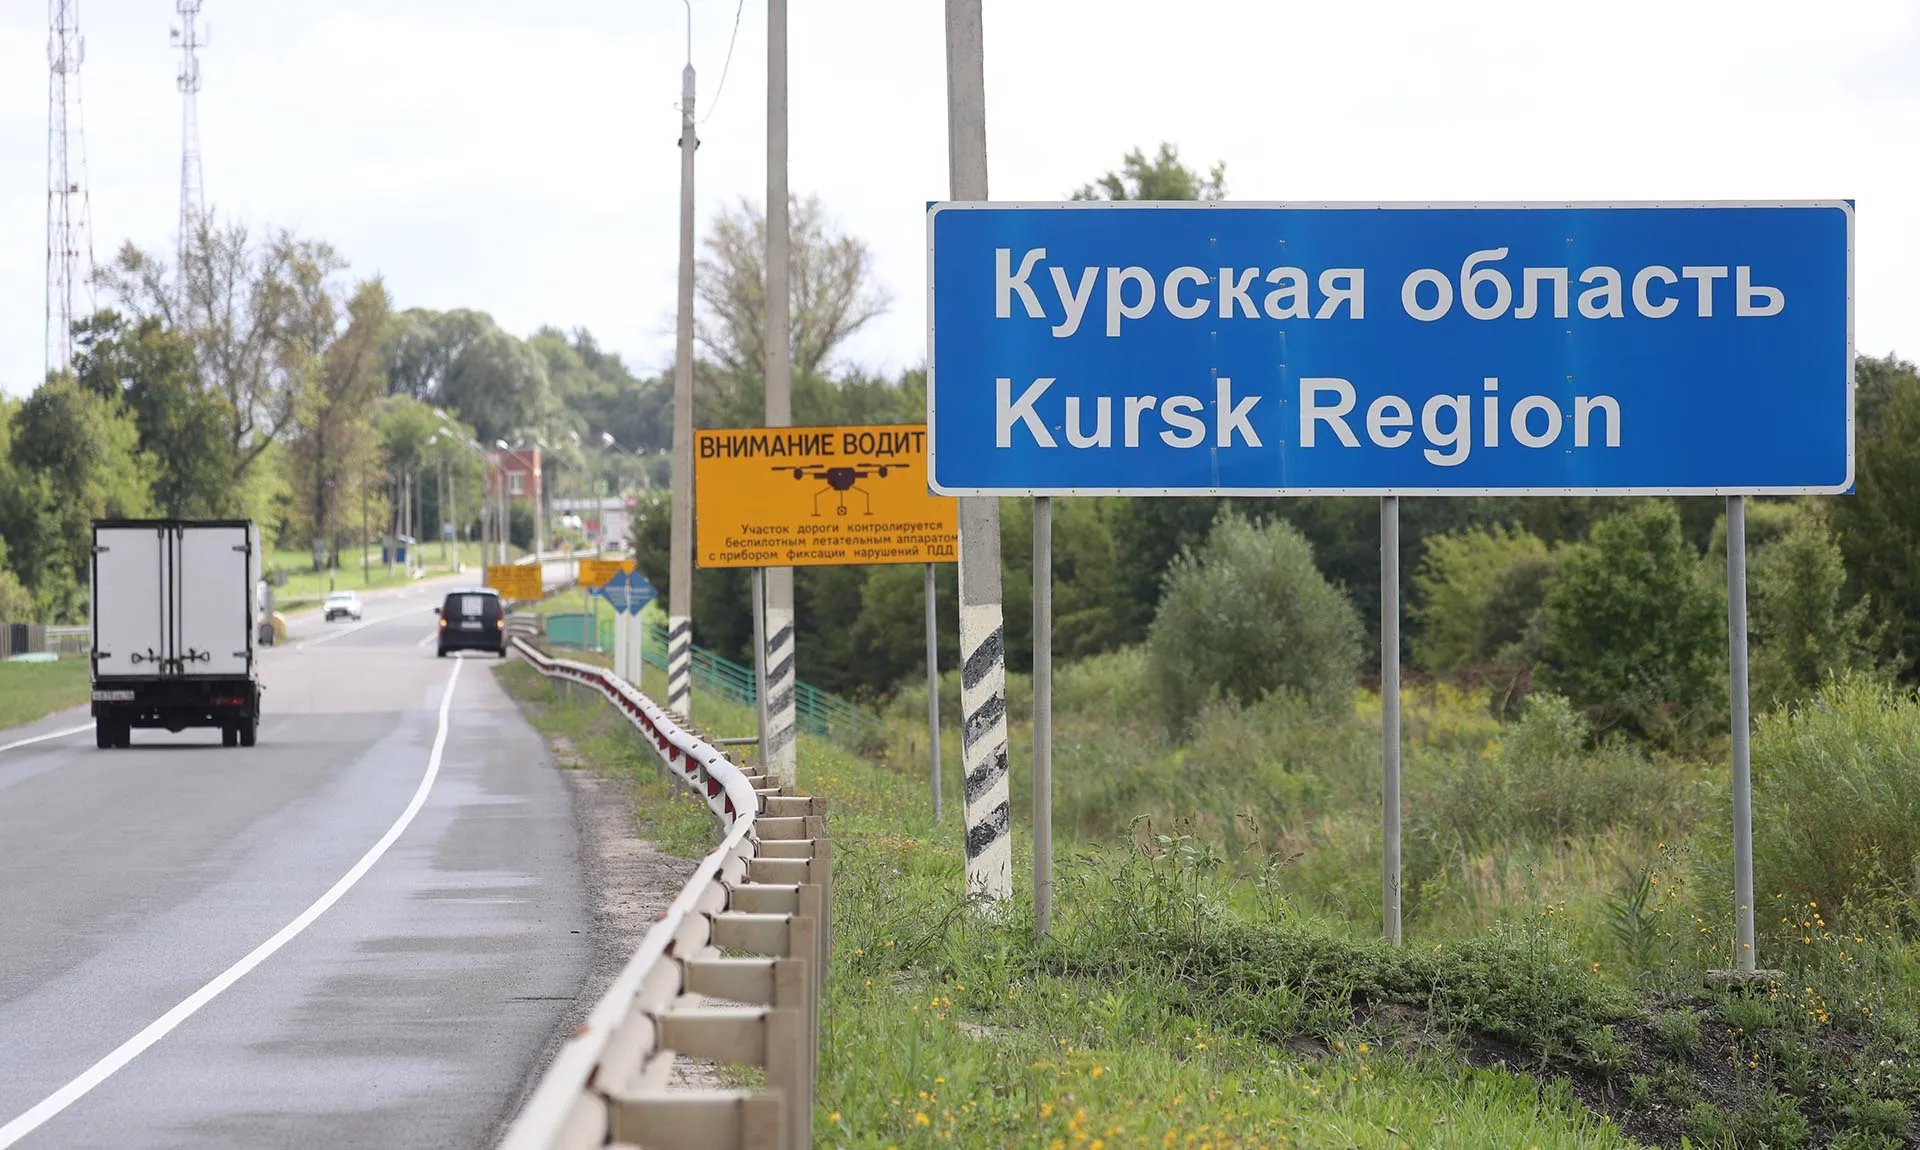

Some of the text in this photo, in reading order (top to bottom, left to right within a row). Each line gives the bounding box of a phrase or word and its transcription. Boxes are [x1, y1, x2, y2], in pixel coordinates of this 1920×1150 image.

[995, 247, 1785, 338] Курская область
[996, 377, 1621, 467] Kursk Region
[700, 431, 927, 459] ВНИМАНИЕ ВОДИТ
[741, 521, 943, 535] Участок дороги контролируется
[708, 543, 954, 562] с прибором фиксации нарушений ПДД
[725, 537, 806, 548] беспилотным
[813, 535, 891, 546] летательным
